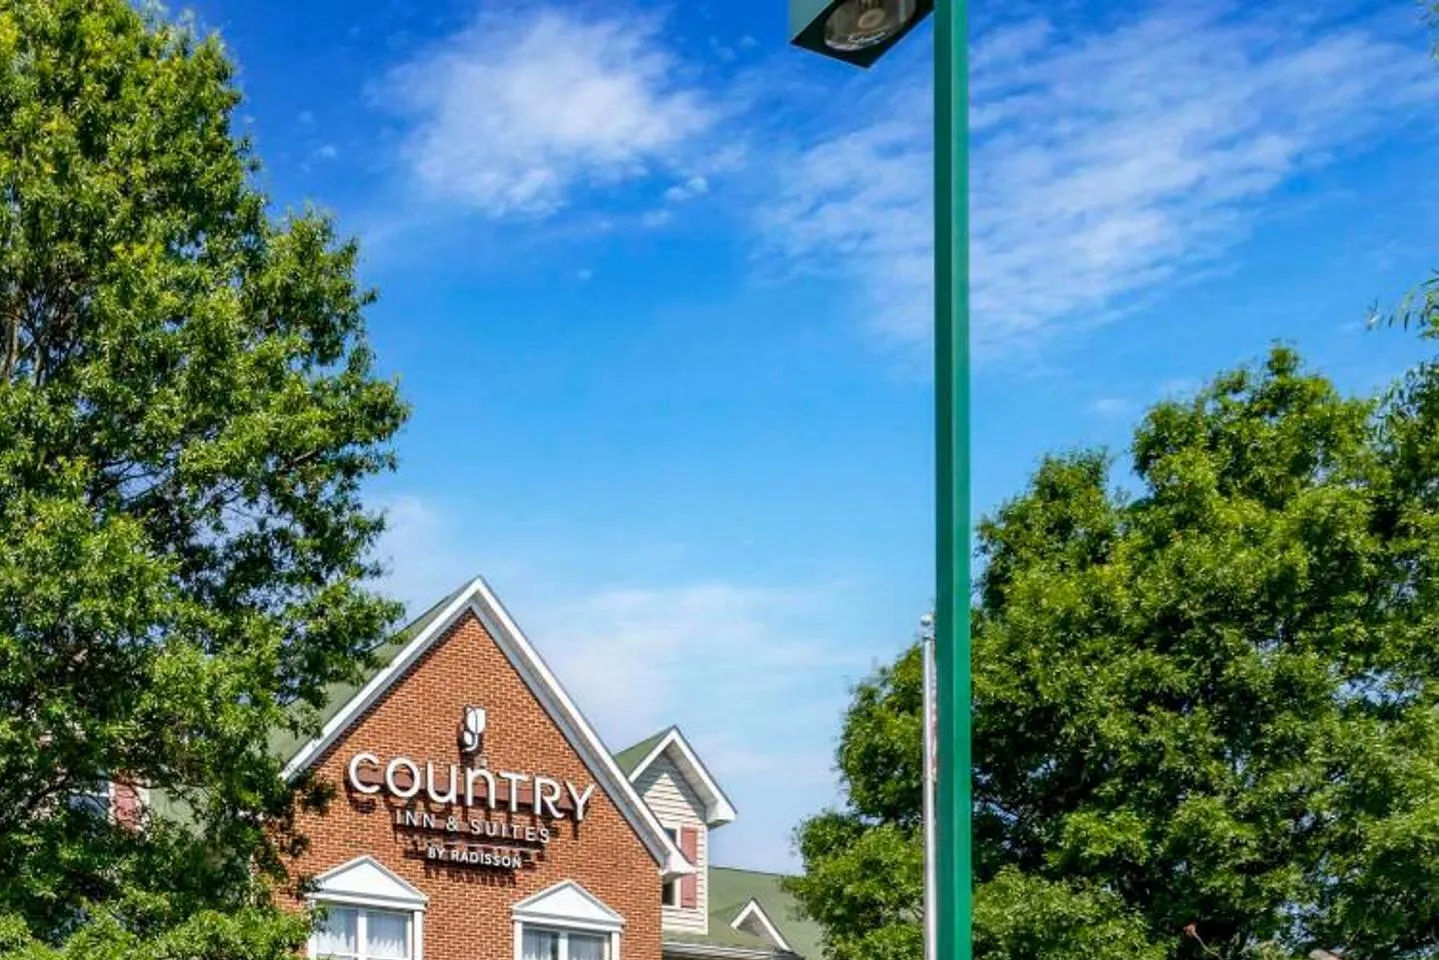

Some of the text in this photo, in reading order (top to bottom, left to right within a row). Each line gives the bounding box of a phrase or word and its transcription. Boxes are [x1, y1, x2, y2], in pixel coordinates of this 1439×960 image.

[396, 809, 550, 844] INN & SUITES
[428, 846, 523, 869] BY RADISSON
